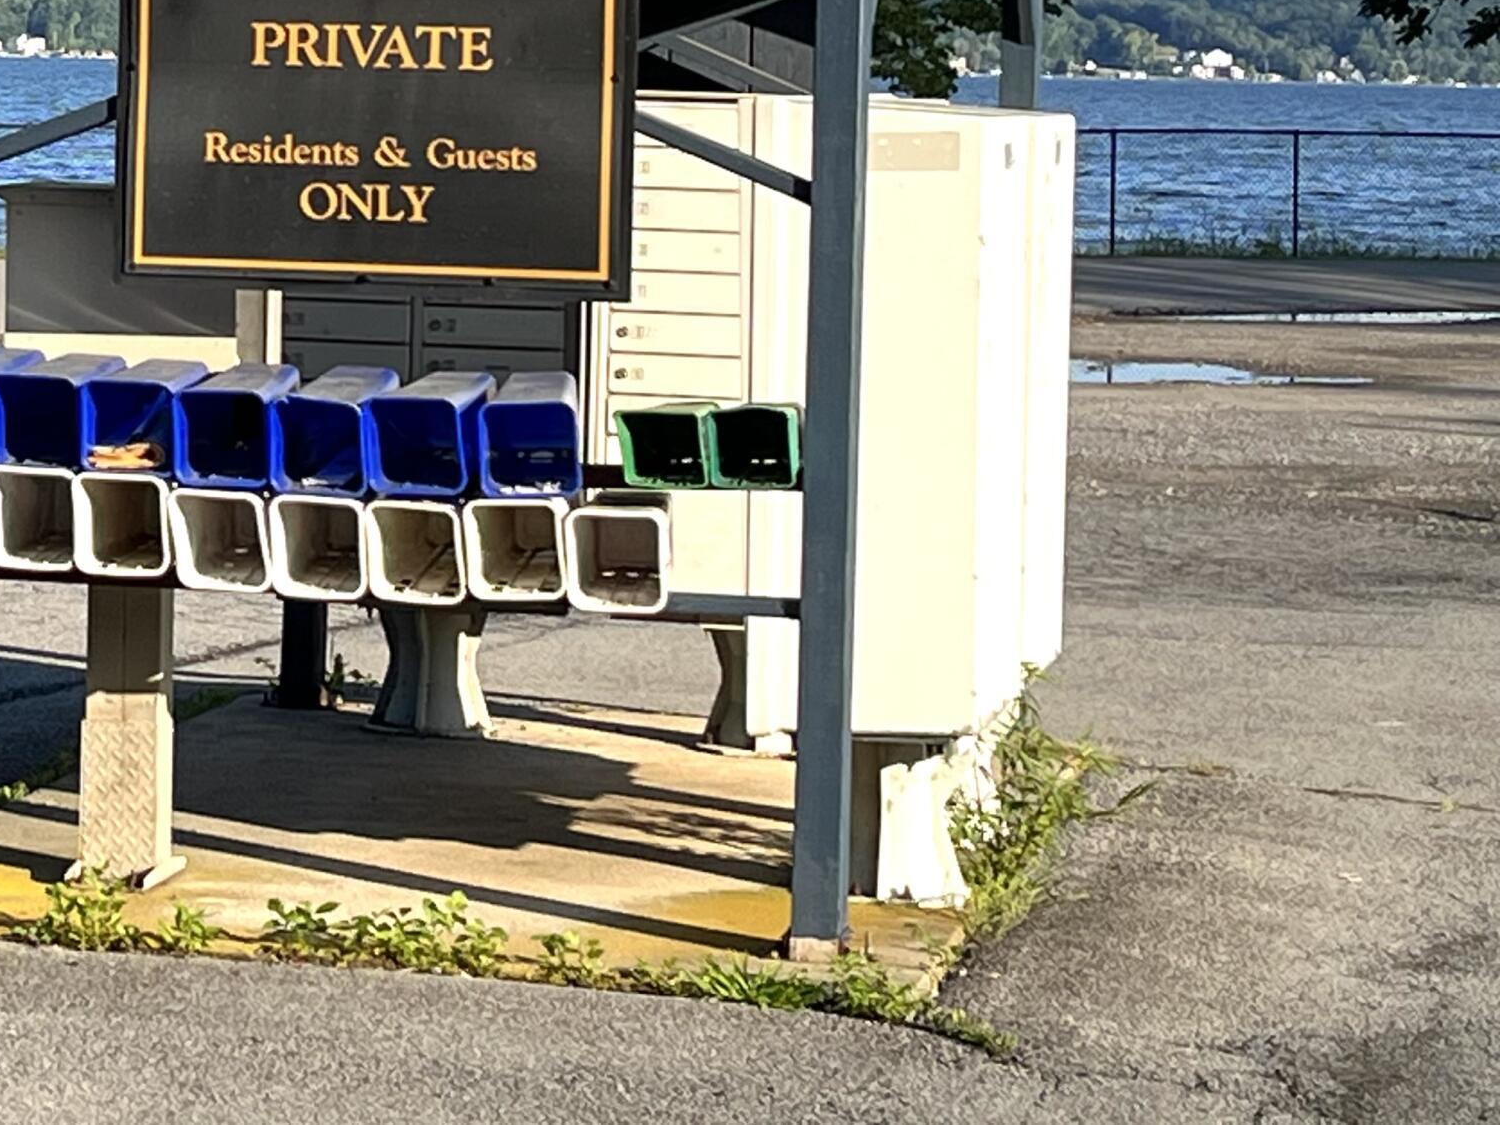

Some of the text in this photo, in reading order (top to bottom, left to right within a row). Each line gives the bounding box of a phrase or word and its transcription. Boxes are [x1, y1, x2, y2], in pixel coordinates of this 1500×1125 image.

[250, 21, 494, 71] PRIVATE
[204, 131, 538, 172] Residents & Guests
[299, 182, 435, 223] ONLY
